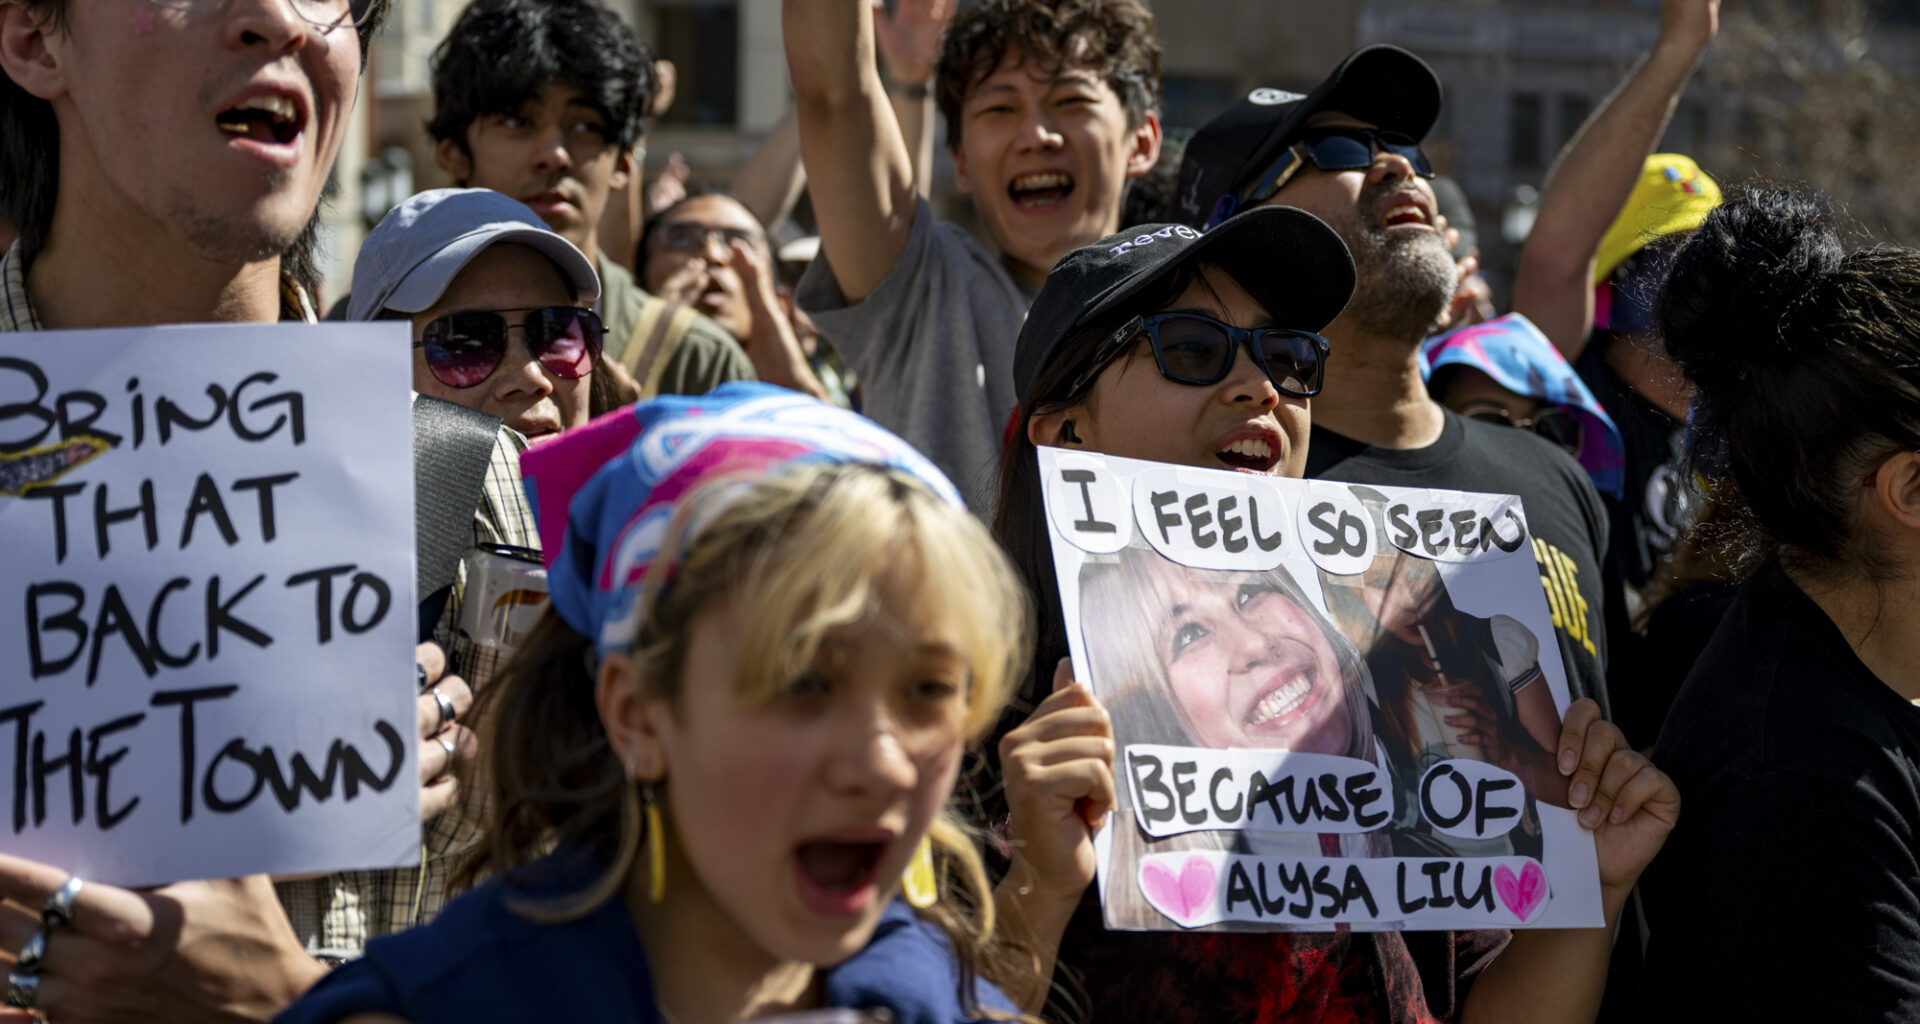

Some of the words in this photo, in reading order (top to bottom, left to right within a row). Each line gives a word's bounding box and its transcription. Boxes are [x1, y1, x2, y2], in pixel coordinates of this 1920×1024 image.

[22, 473, 299, 563] THAT
[1061, 469, 1116, 533] I
[1151, 489, 1282, 552] FEEL
[1307, 501, 1368, 558] SO
[1388, 503, 1526, 554] SEEN
[25, 575, 273, 687] BACK
[286, 564, 391, 643] TO
[0, 700, 146, 834] THE
[1128, 750, 1390, 828] BECAUSE
[1421, 763, 1520, 836] OF
[1226, 860, 1380, 919] ALYSA
[1396, 861, 1495, 914] LIU
